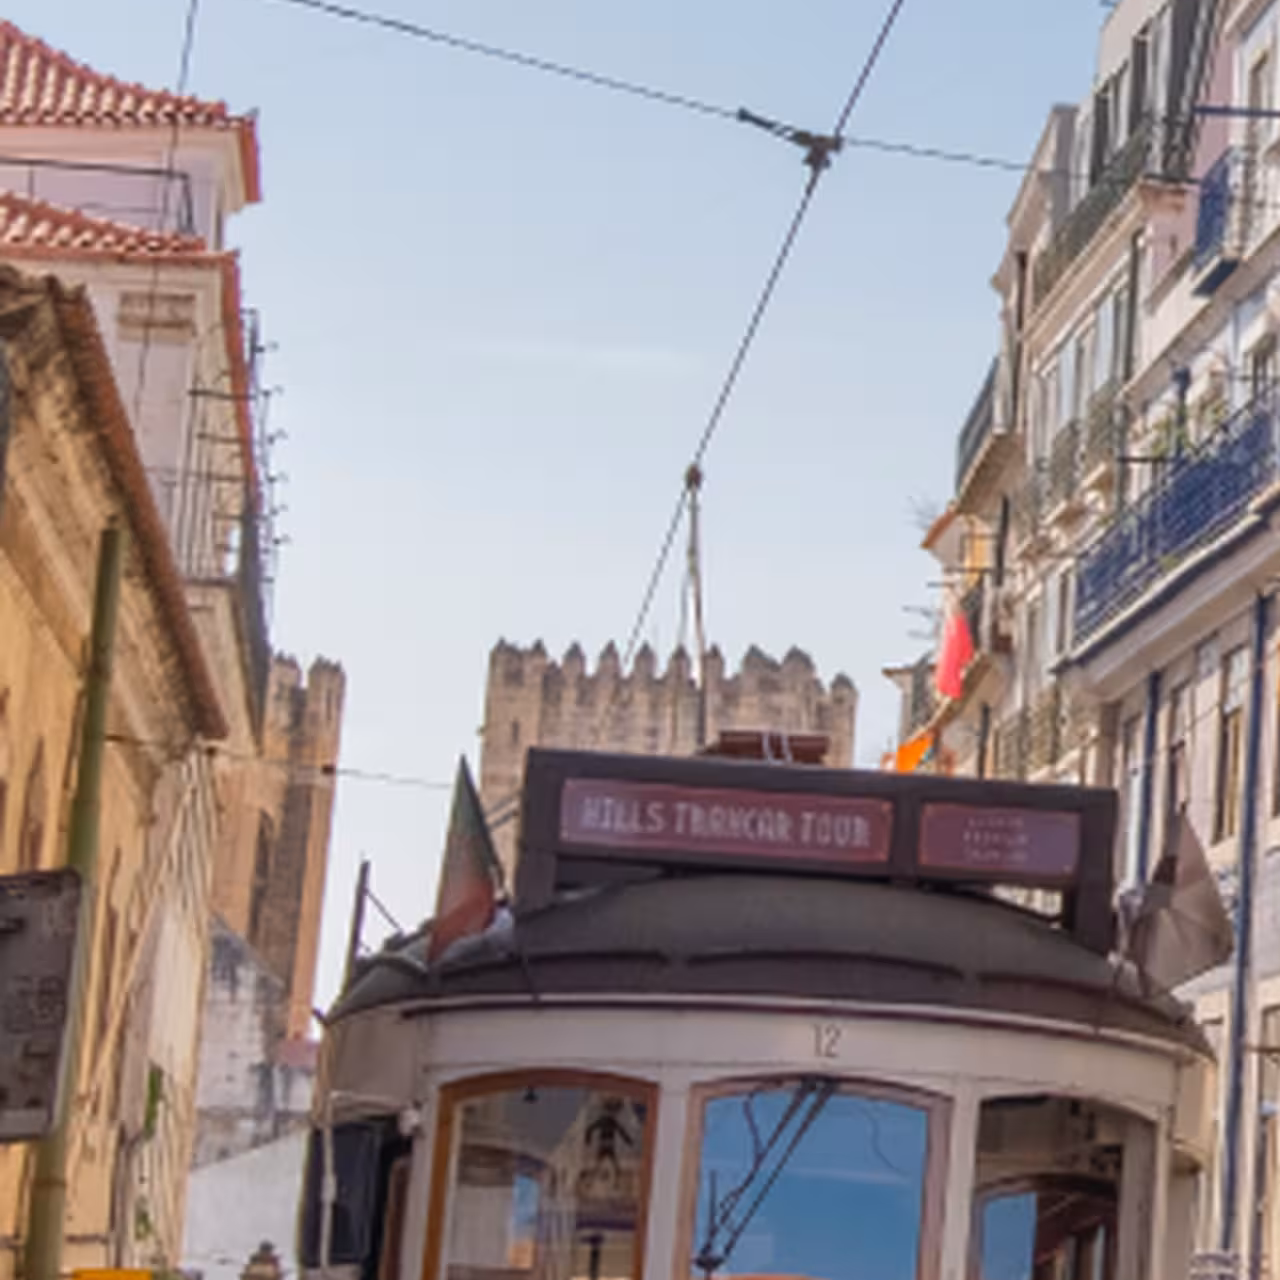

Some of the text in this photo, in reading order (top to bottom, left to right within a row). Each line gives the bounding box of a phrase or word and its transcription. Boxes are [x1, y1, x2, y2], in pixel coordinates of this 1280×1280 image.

[580, 796, 664, 833] HILLS
[800, 811, 871, 848] TOUR
[813, 1023, 841, 1058] 12
